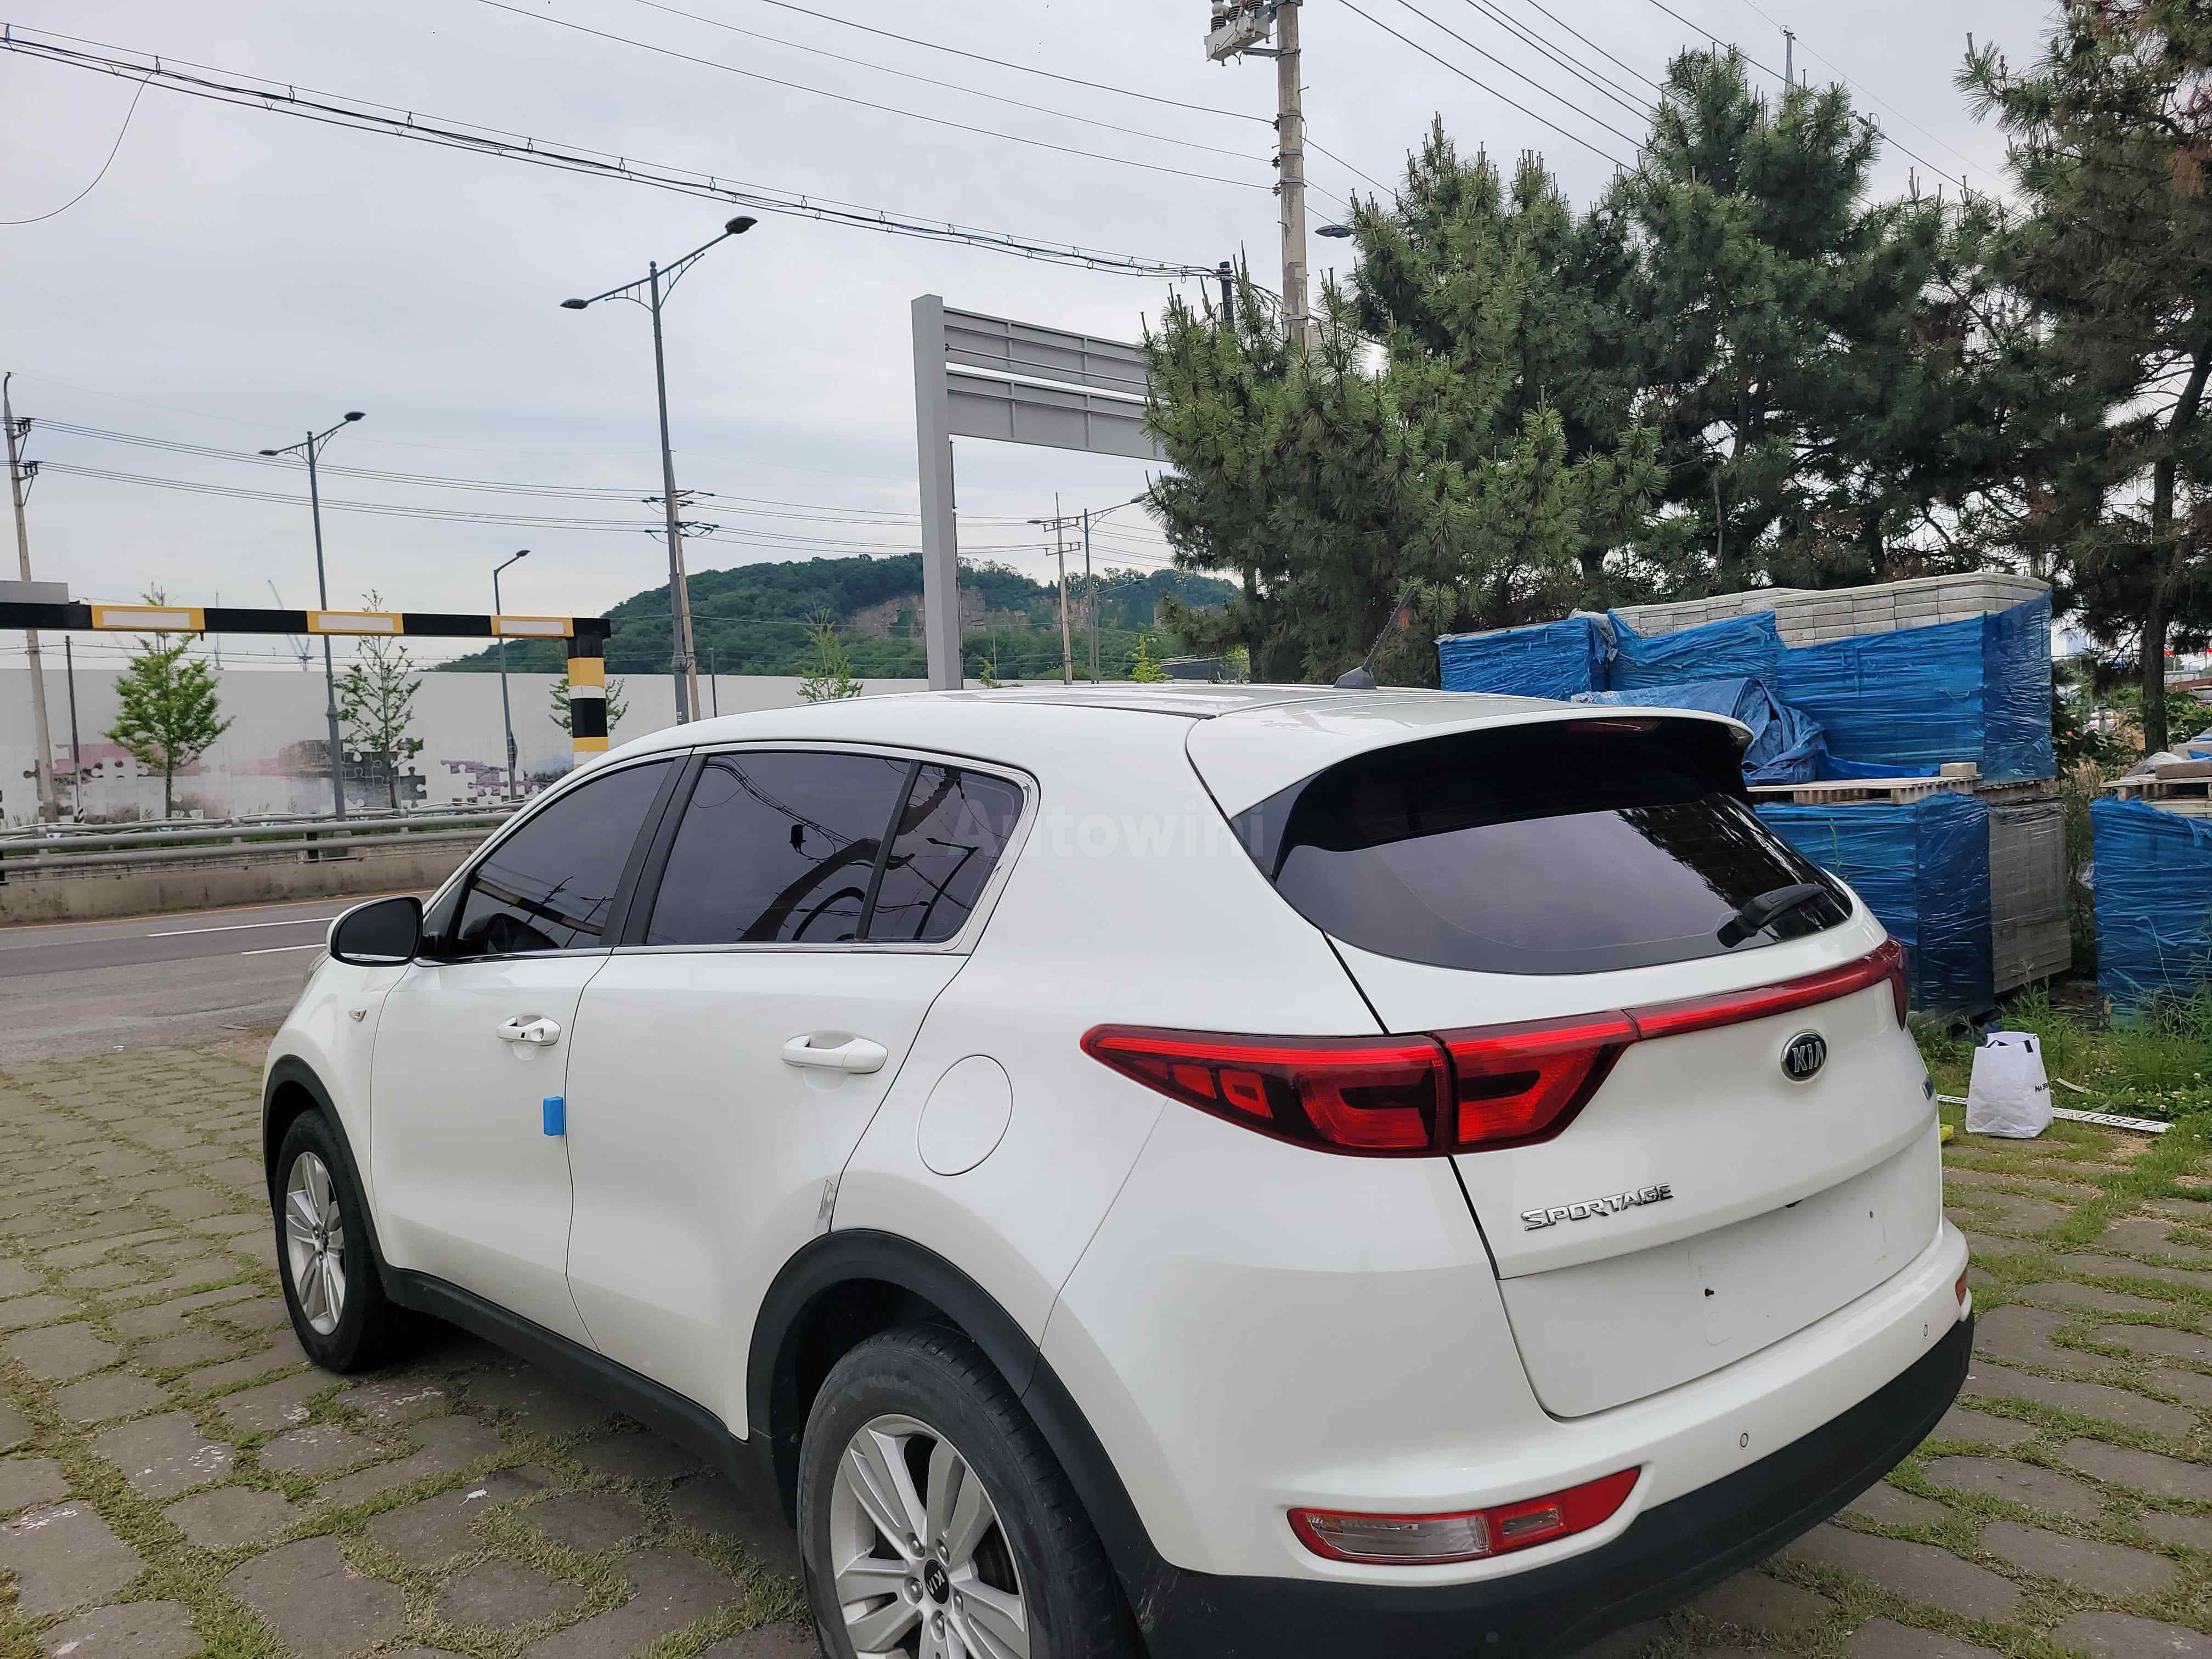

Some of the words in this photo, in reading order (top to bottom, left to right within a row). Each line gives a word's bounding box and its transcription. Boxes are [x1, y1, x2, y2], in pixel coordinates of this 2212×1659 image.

[1791, 1041, 1825, 1073] KIA
[1520, 1182, 1674, 1232] SPORTAGE
[926, 1570, 945, 1595] KIA
